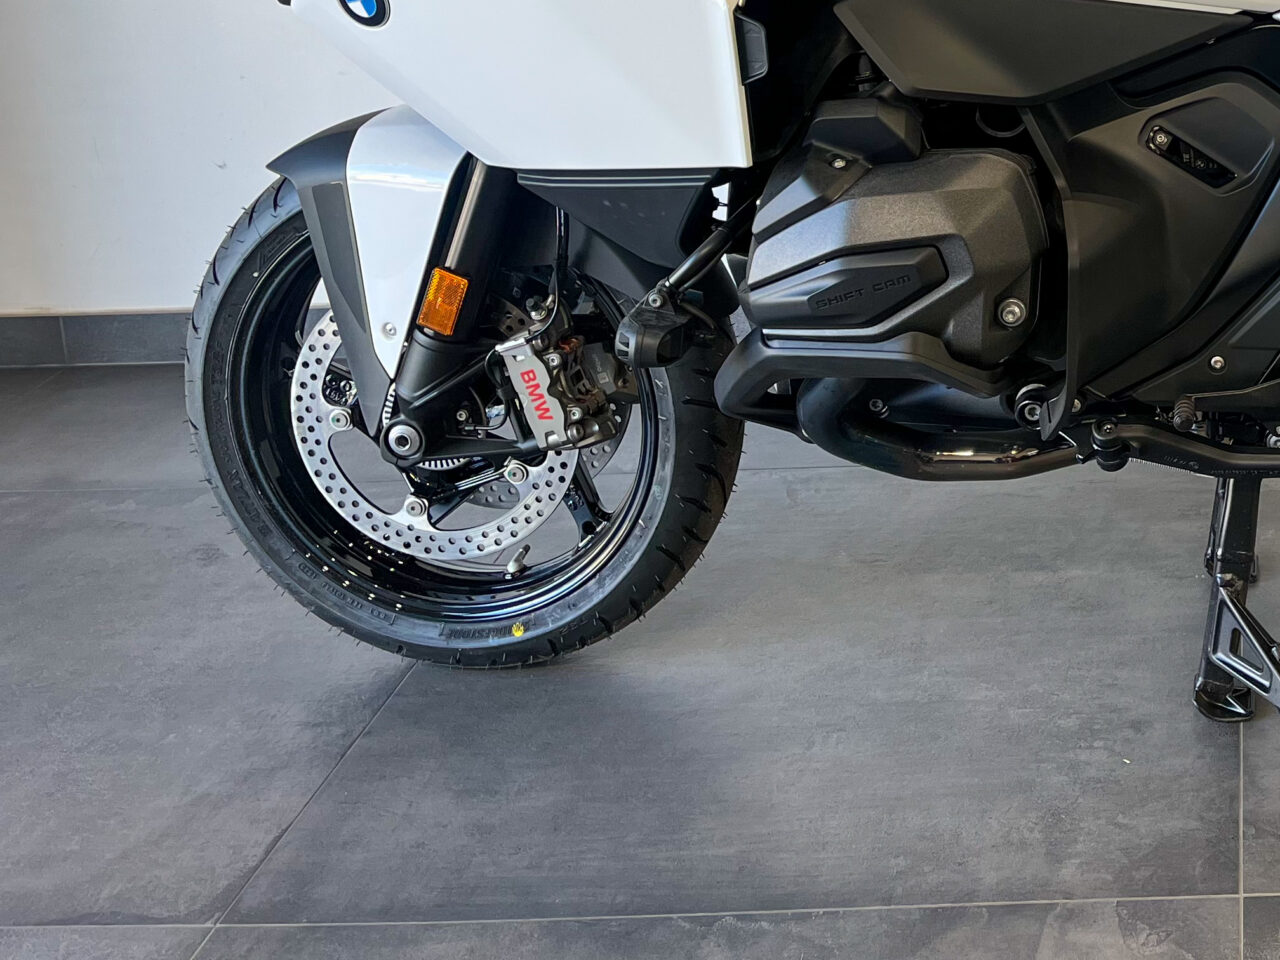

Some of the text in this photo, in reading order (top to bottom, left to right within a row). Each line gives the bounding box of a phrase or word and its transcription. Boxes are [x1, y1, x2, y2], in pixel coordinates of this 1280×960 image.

[815, 274, 912, 311] SHIFT CAM
[520, 368, 554, 421] BMW
